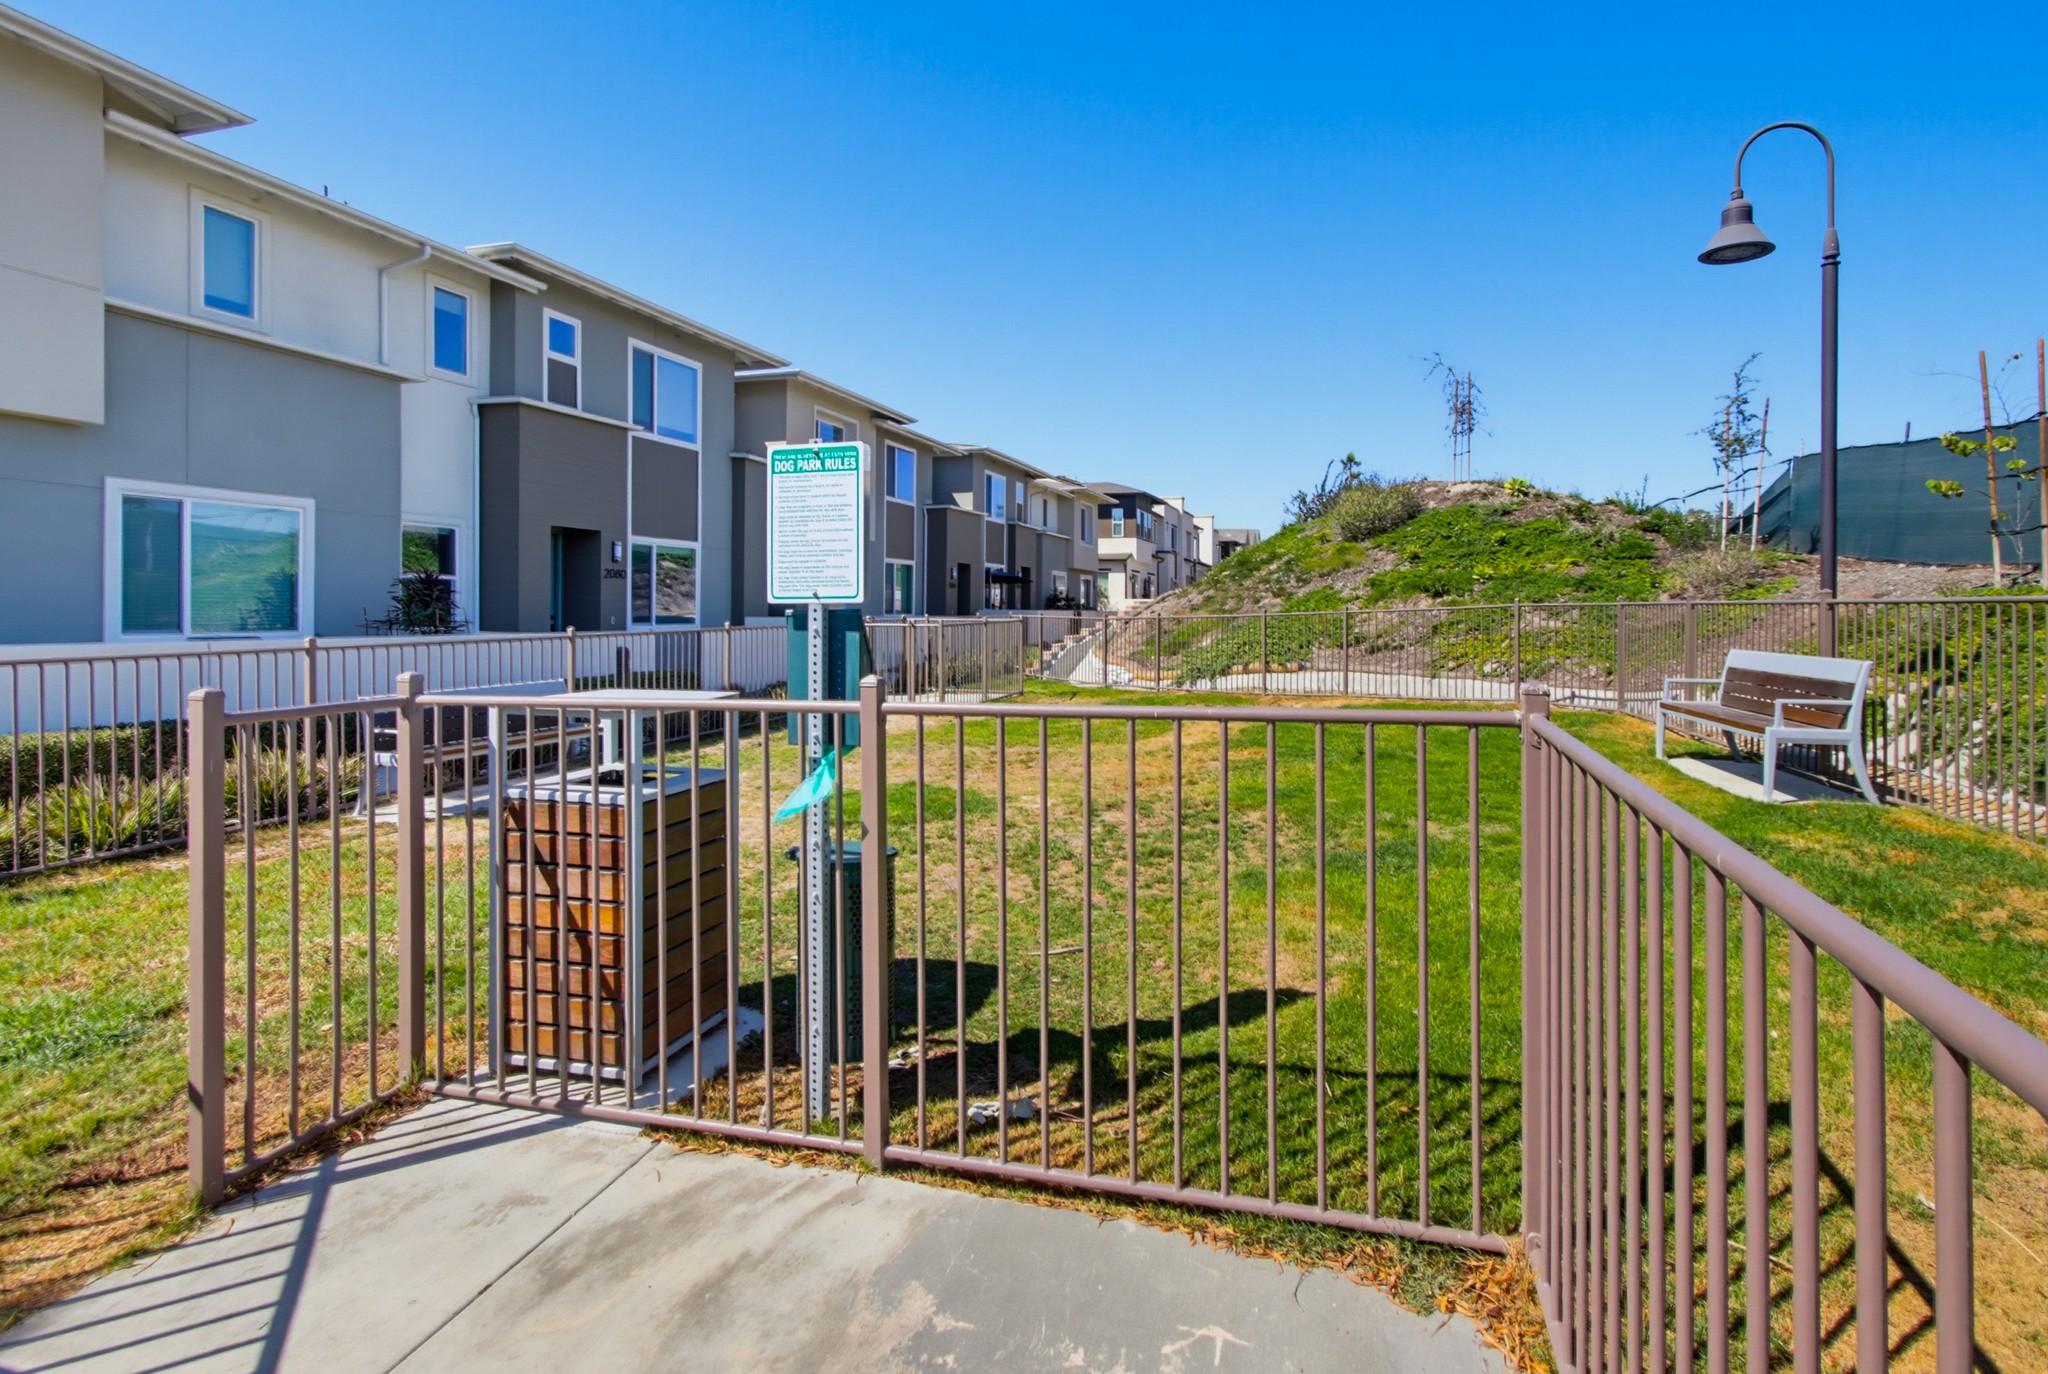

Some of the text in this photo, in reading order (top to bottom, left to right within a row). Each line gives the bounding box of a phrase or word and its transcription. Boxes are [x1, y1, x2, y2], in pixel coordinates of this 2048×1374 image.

[774, 457, 857, 473] DOG PARK RULES
